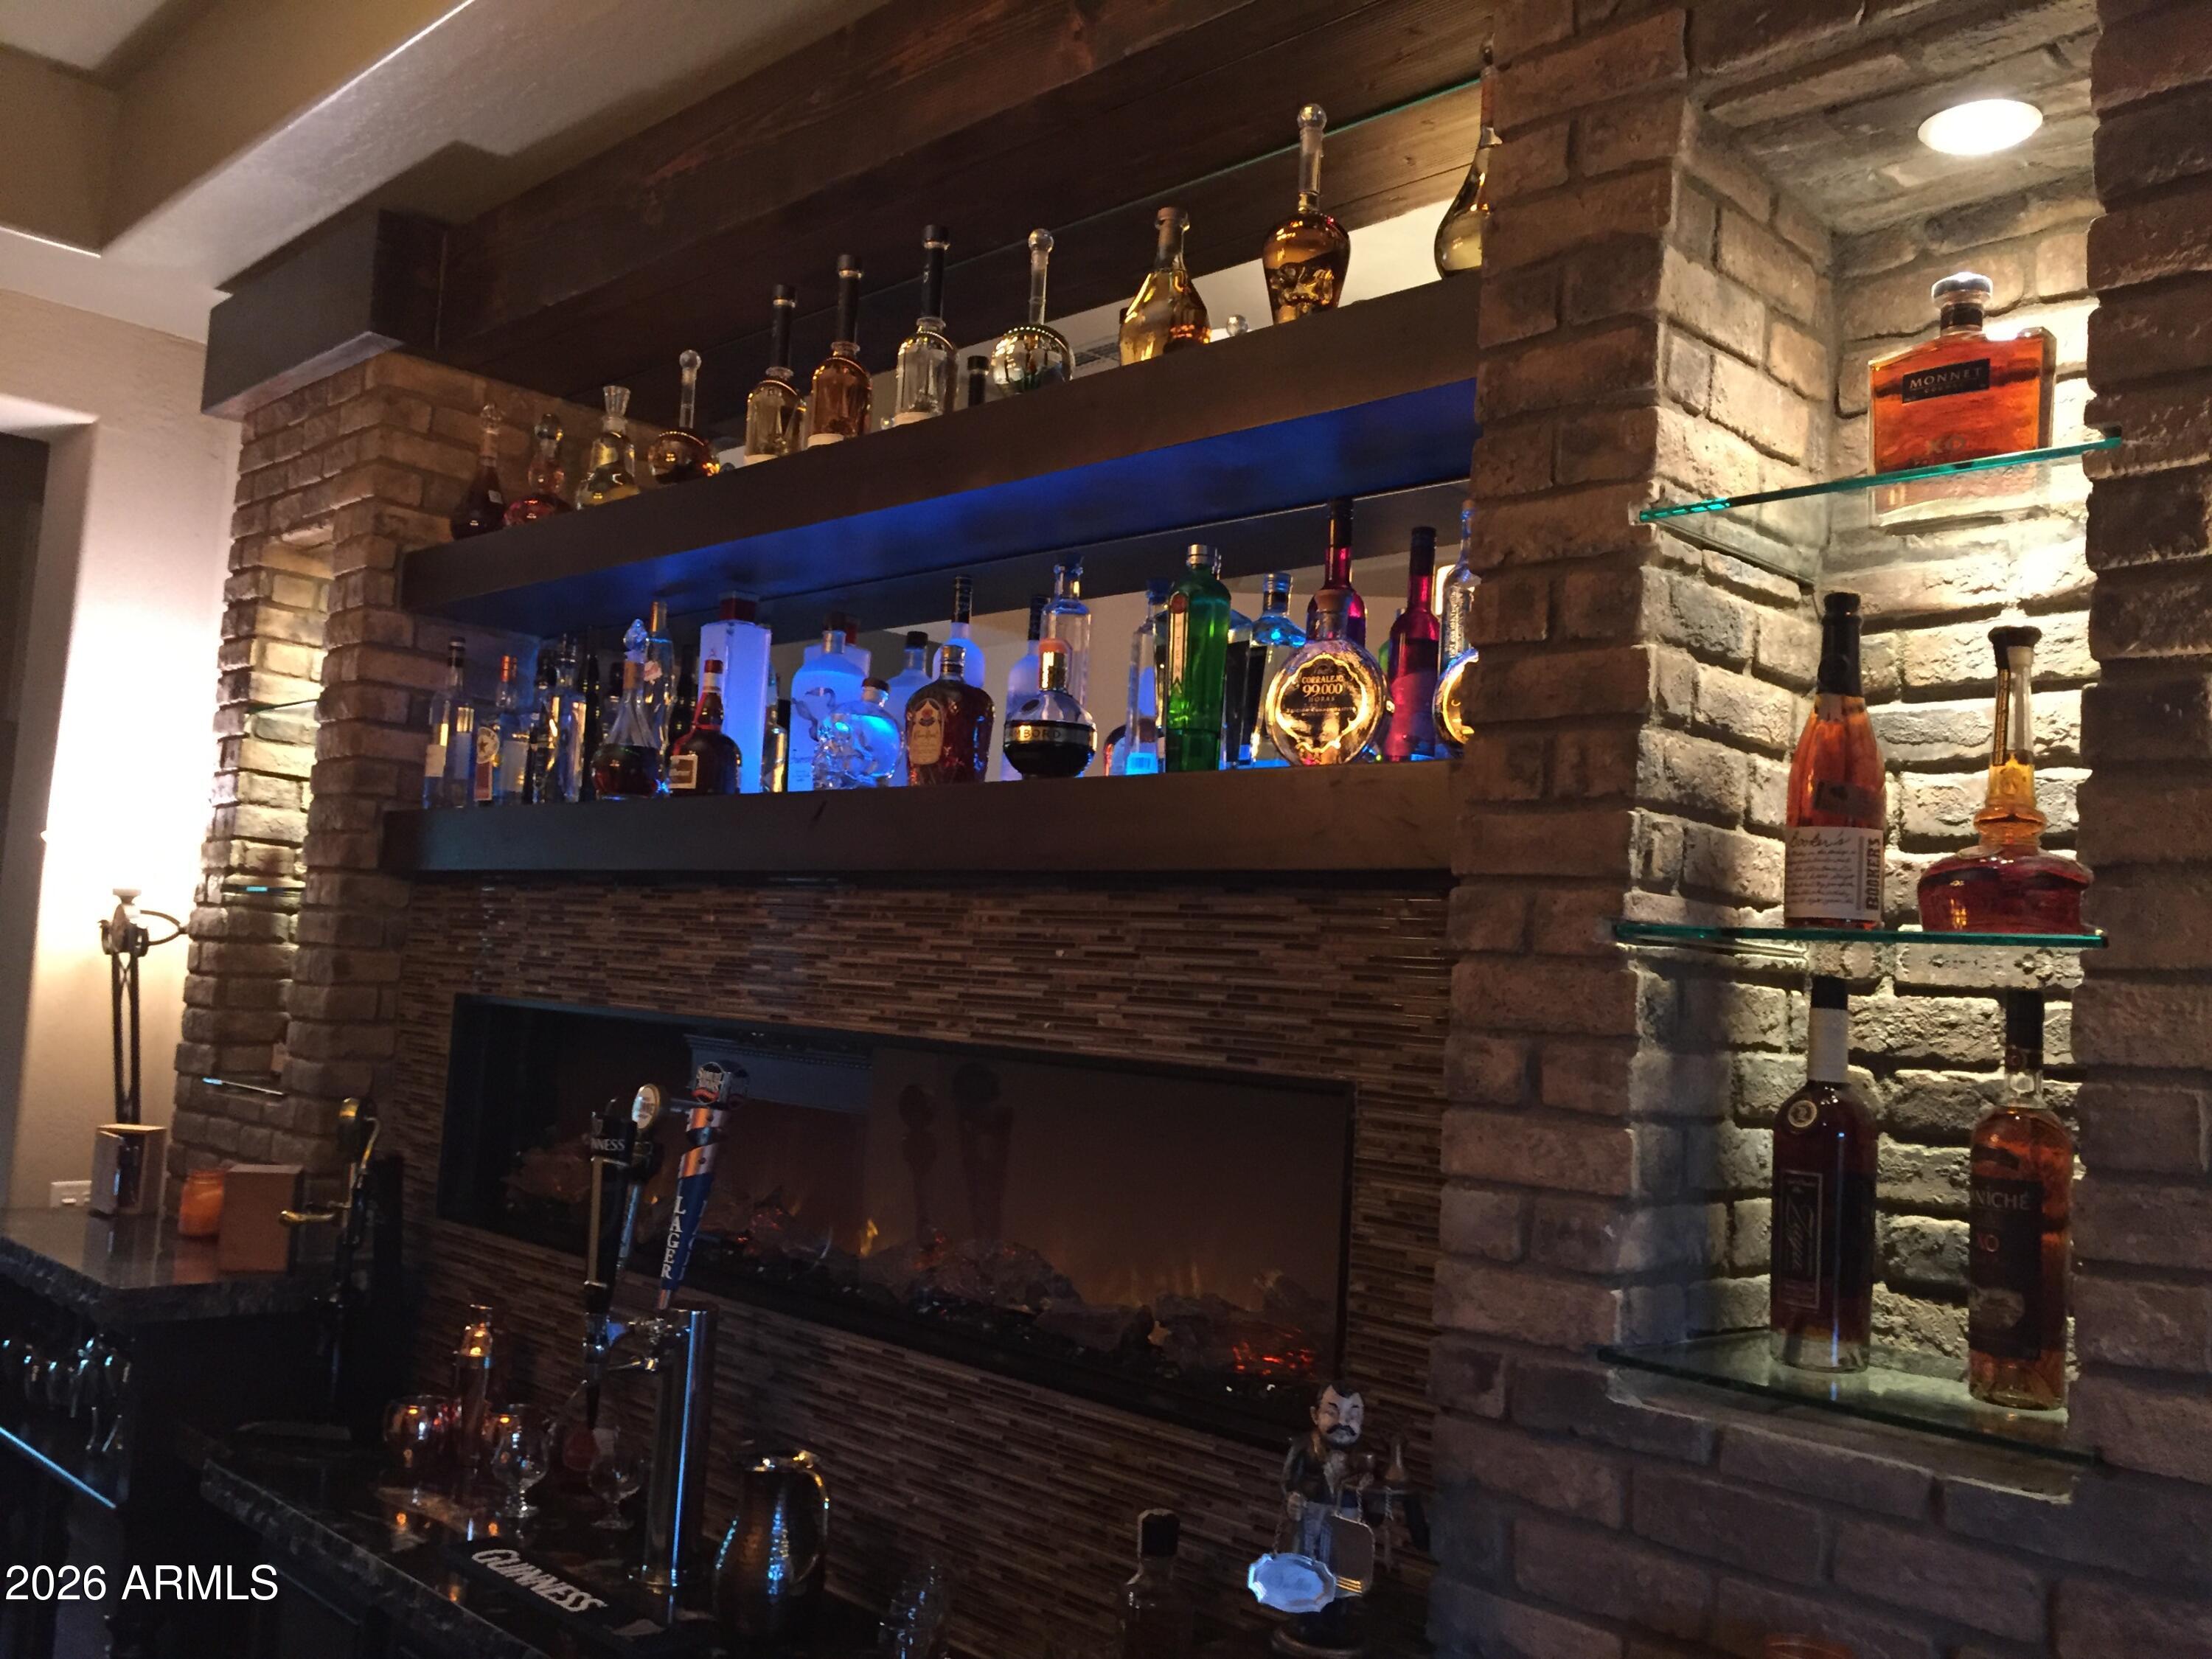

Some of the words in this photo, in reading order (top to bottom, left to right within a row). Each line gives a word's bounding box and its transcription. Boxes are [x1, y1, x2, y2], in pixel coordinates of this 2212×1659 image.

[1910, 367, 1982, 389] MONNET
[1301, 675, 1343, 684] CORRALEJO
[661, 1195, 686, 1280] LAGER
[472, 1549, 609, 1613] GUINNESS
